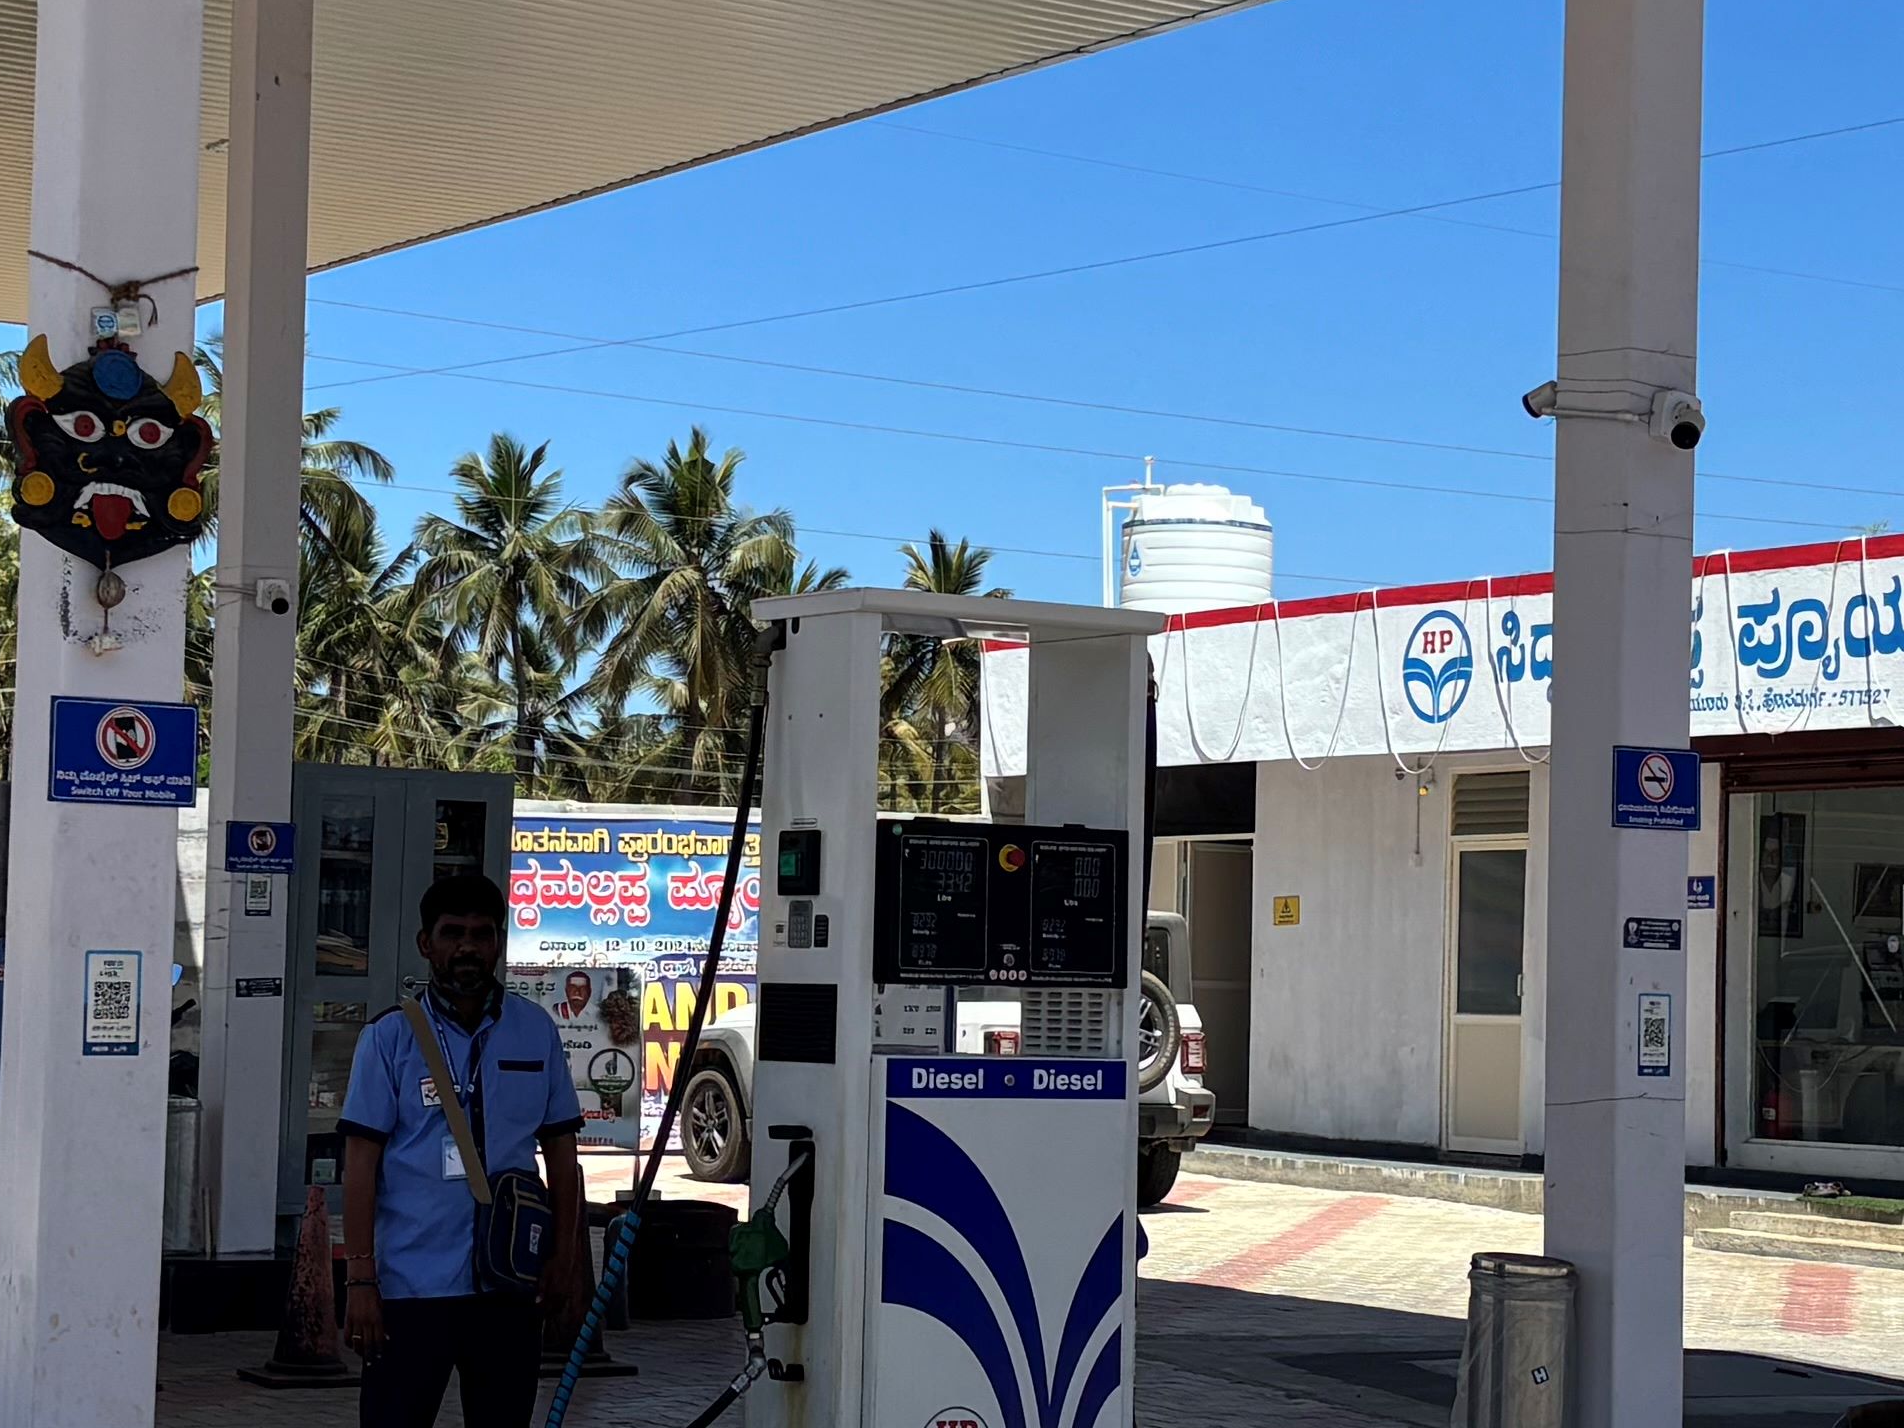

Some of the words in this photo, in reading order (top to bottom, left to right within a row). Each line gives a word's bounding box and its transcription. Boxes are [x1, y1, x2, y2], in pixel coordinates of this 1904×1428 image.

[1422, 630, 1453, 654] HP
[71, 786, 103, 796] Switch
[106, 787, 119, 796] Off
[122, 789, 142, 797] Your
[145, 790, 176, 799] Mobile
[912, 1068, 984, 1089] Diesel
[1033, 1069, 1103, 1091] Diesel
